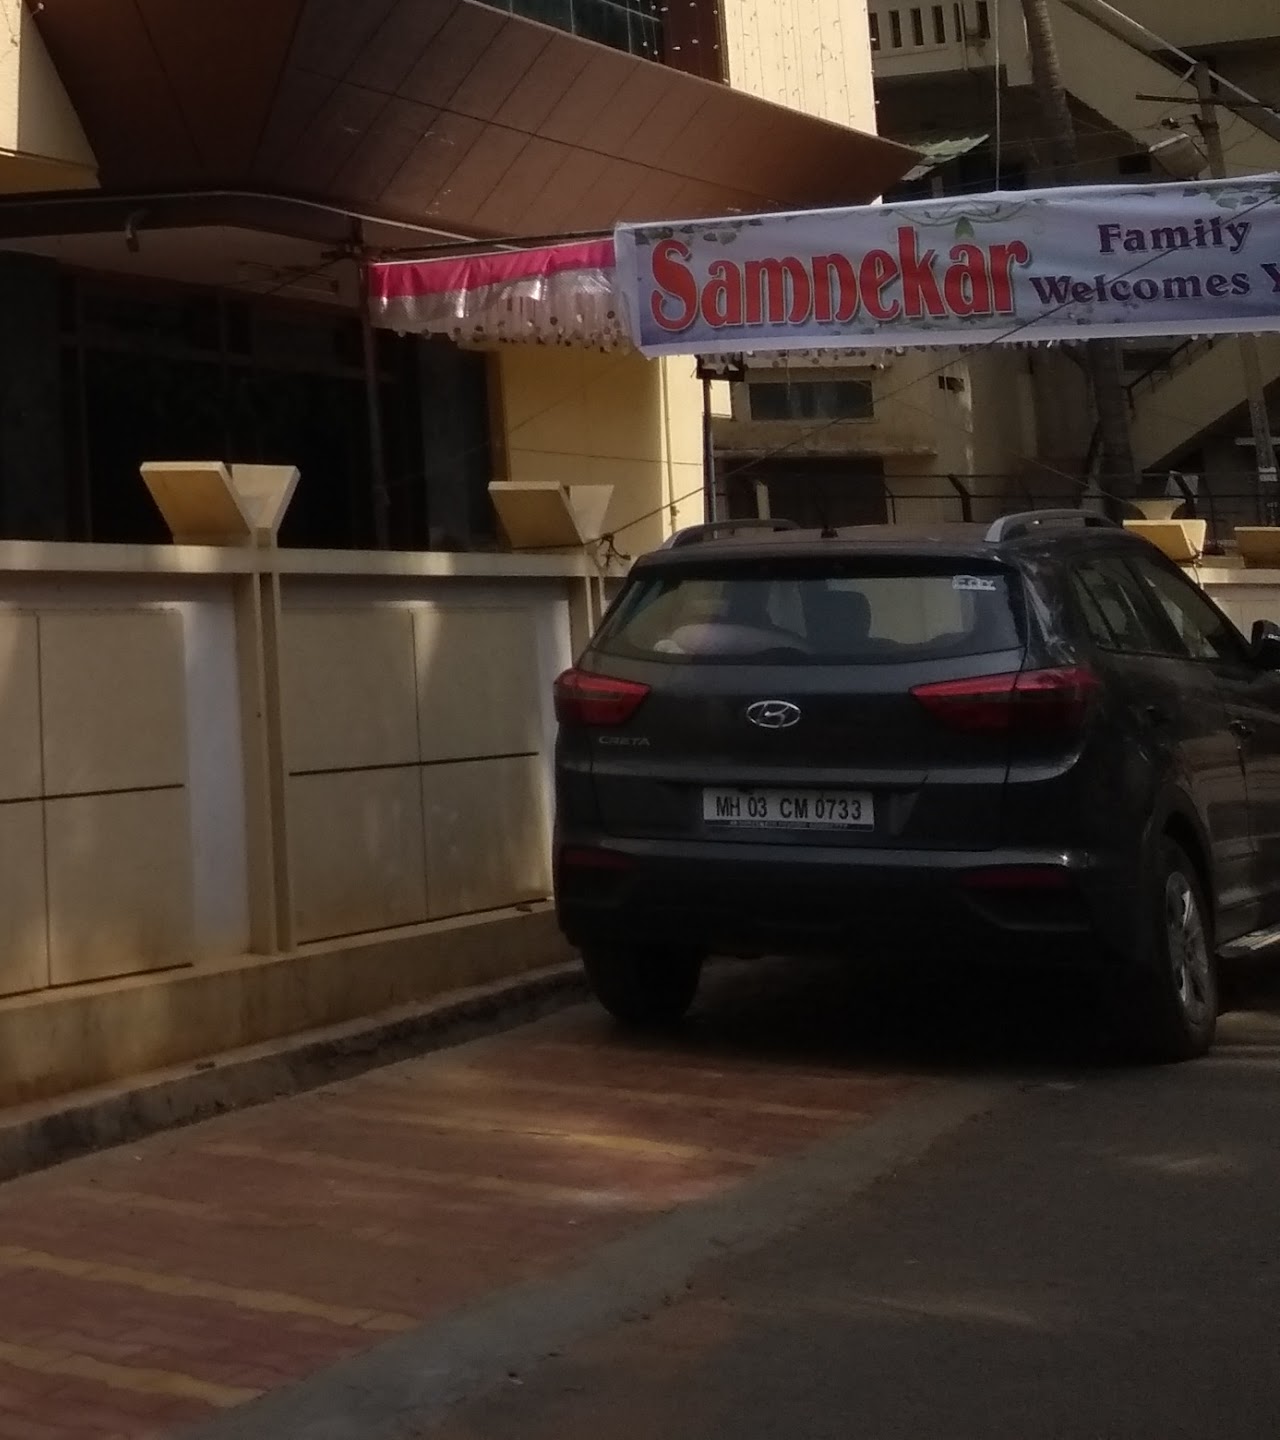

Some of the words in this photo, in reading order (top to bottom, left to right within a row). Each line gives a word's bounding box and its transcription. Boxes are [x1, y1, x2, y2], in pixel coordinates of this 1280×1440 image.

[1098, 216, 1250, 254] Family
[650, 226, 1030, 332] Samnekar
[1029, 272, 1251, 305] Welcomes
[716, 796, 741, 817] MH
[747, 797, 768, 818] 03
[780, 798, 809, 819] CM
[815, 799, 862, 821] 0733
